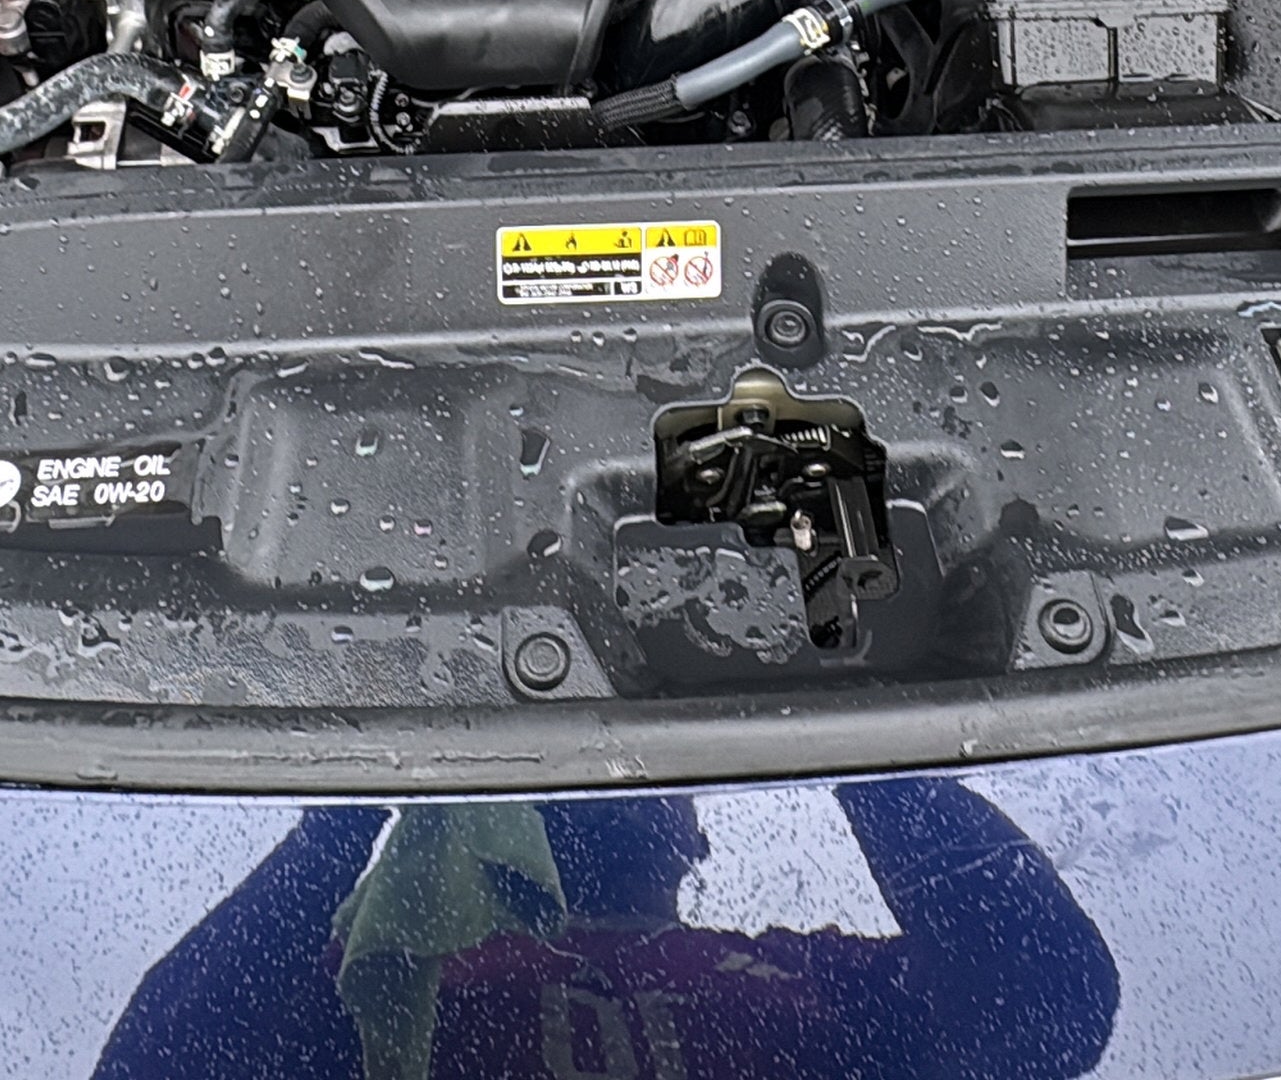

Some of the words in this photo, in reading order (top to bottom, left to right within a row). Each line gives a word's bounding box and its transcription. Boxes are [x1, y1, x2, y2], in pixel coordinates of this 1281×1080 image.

[37, 456, 121, 480] ENGINE
[134, 454, 171, 476] OIL
[31, 484, 80, 507] SAE
[94, 480, 165, 505] 0W-20
